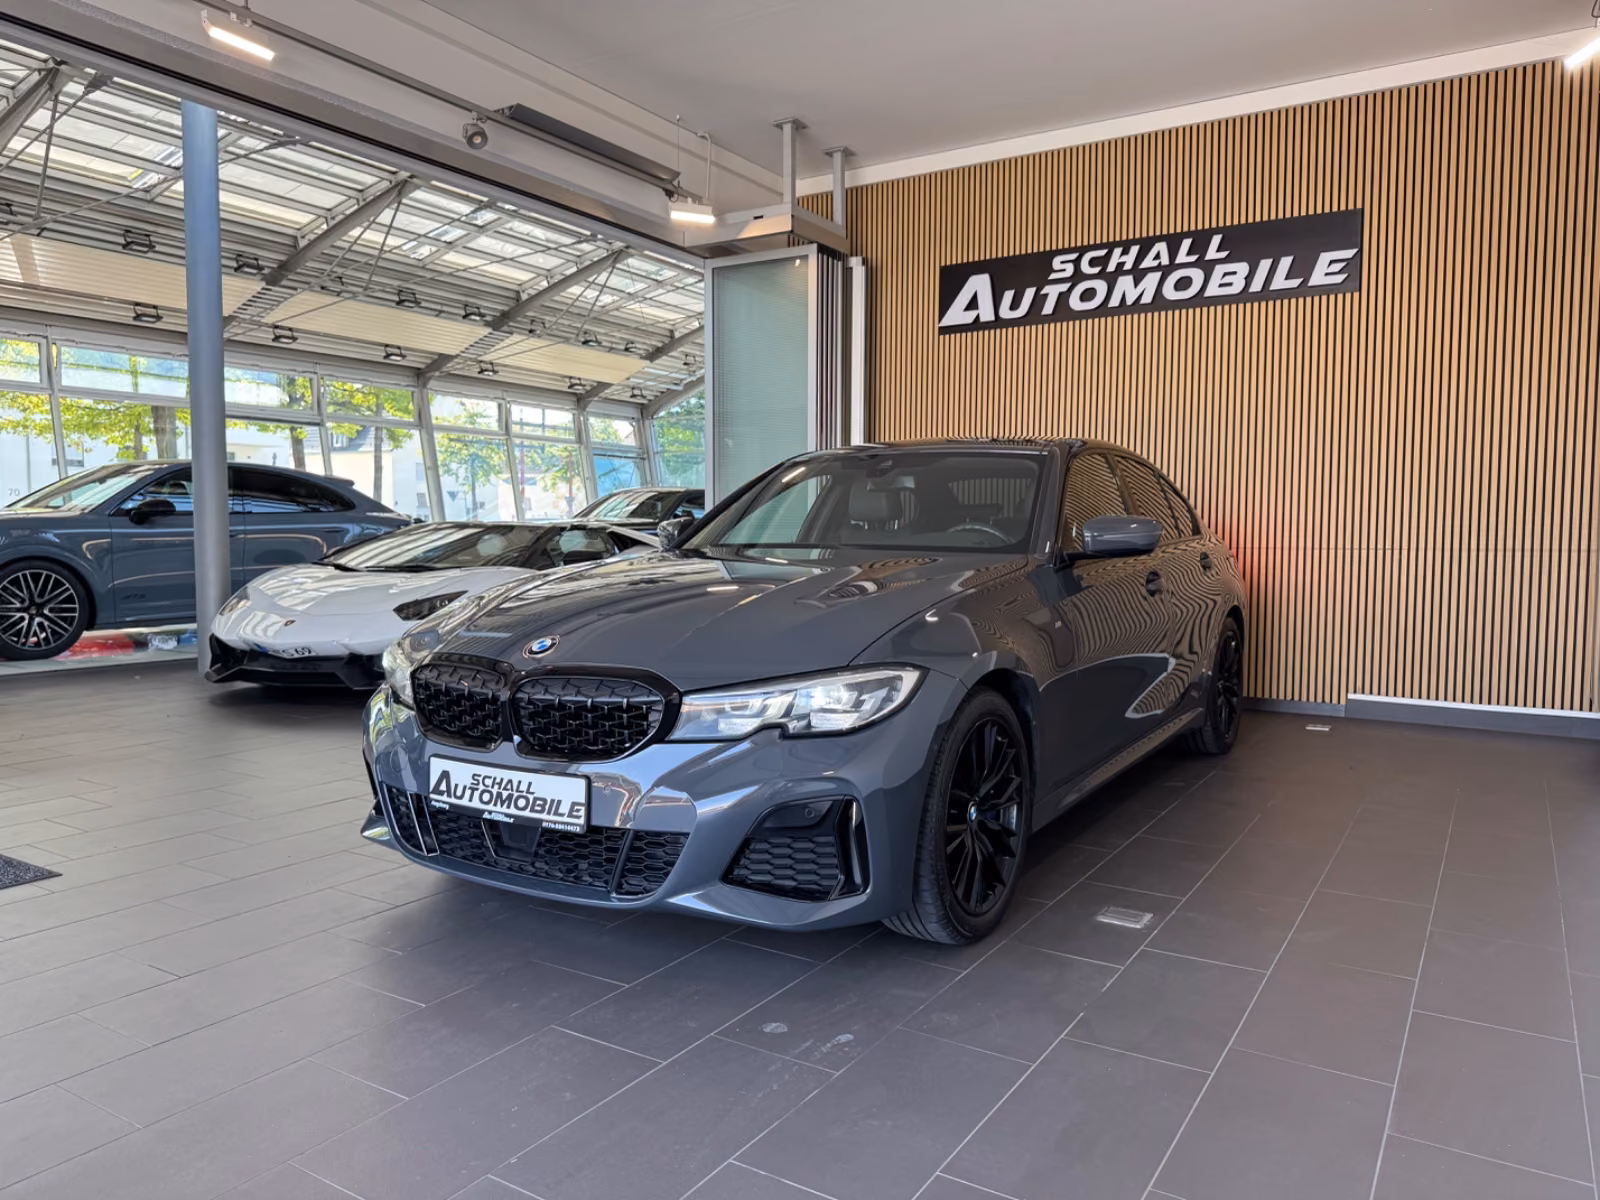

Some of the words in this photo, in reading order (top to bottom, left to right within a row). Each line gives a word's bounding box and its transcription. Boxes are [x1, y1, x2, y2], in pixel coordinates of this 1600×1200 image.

[1048, 233, 1231, 281] SCHALL
[938, 248, 1360, 327] AUTOMOBILE
[8, 488, 20, 497] 70
[430, 769, 586, 820] AUTOMOBILE
[470, 773, 536, 795] SCHALL
